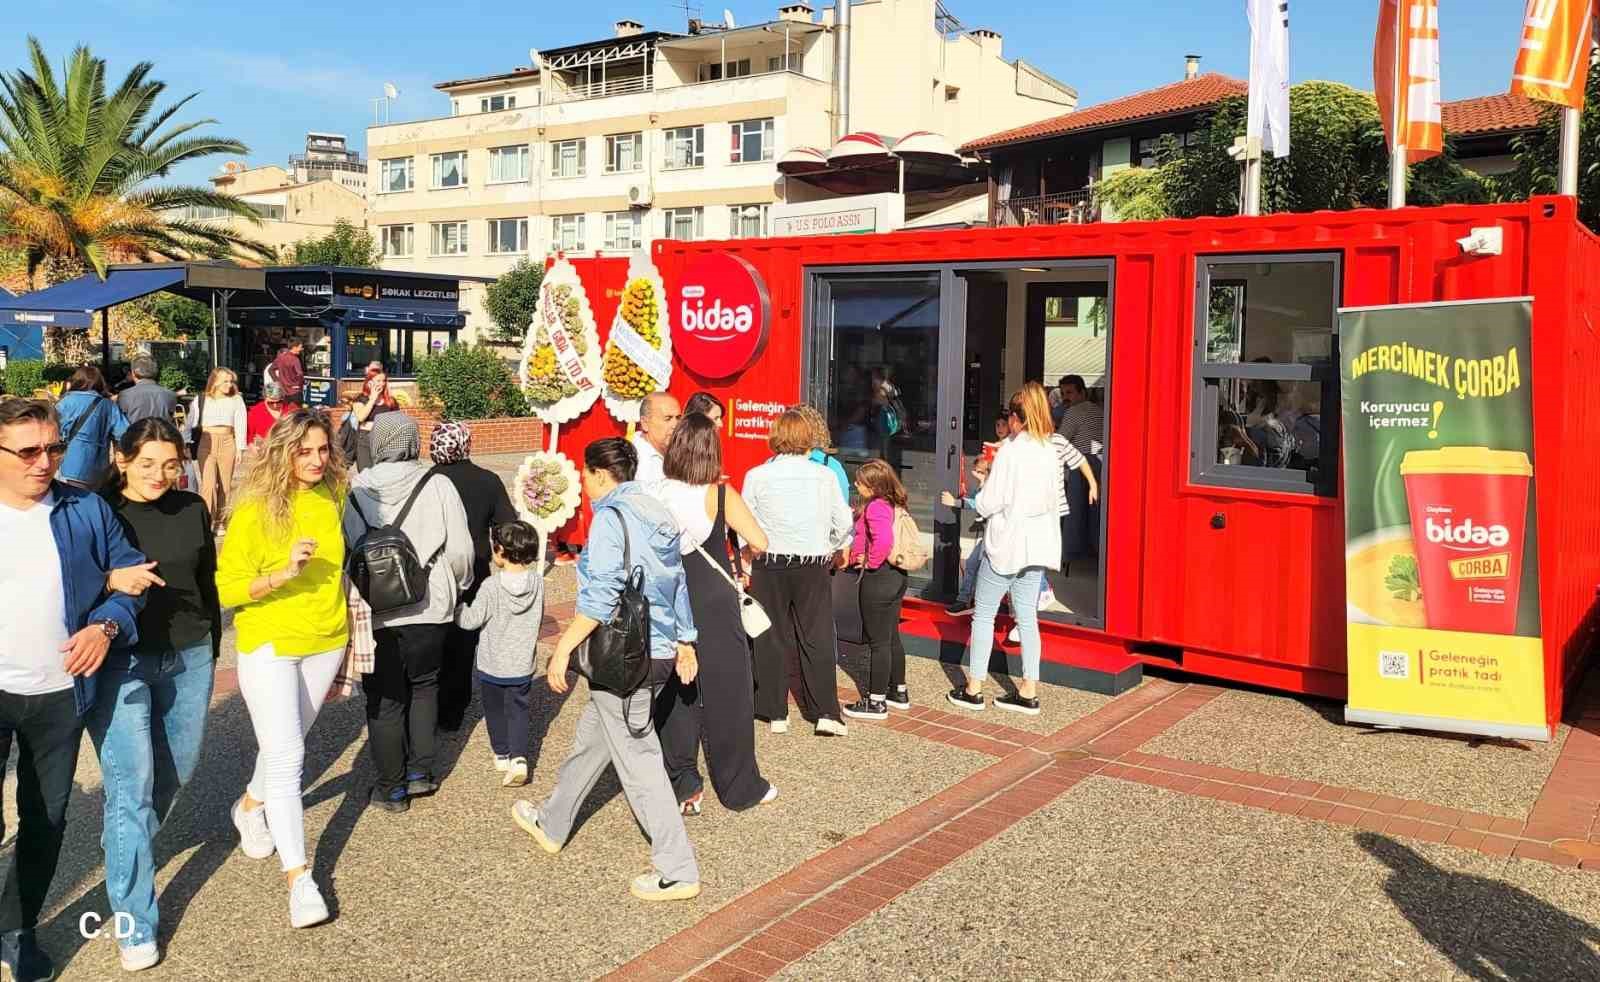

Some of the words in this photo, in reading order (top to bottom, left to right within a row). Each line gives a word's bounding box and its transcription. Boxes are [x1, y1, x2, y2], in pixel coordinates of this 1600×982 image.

[681, 298, 753, 333] bidaa
[1351, 341, 1450, 390] MERCİMEK
[1454, 347, 1521, 400] ÇORBA
[1360, 401, 1430, 415] Koruyucu
[1369, 416, 1430, 429] içermez
[1426, 517, 1510, 547] bidaa
[1429, 667, 1470, 679] pratik
